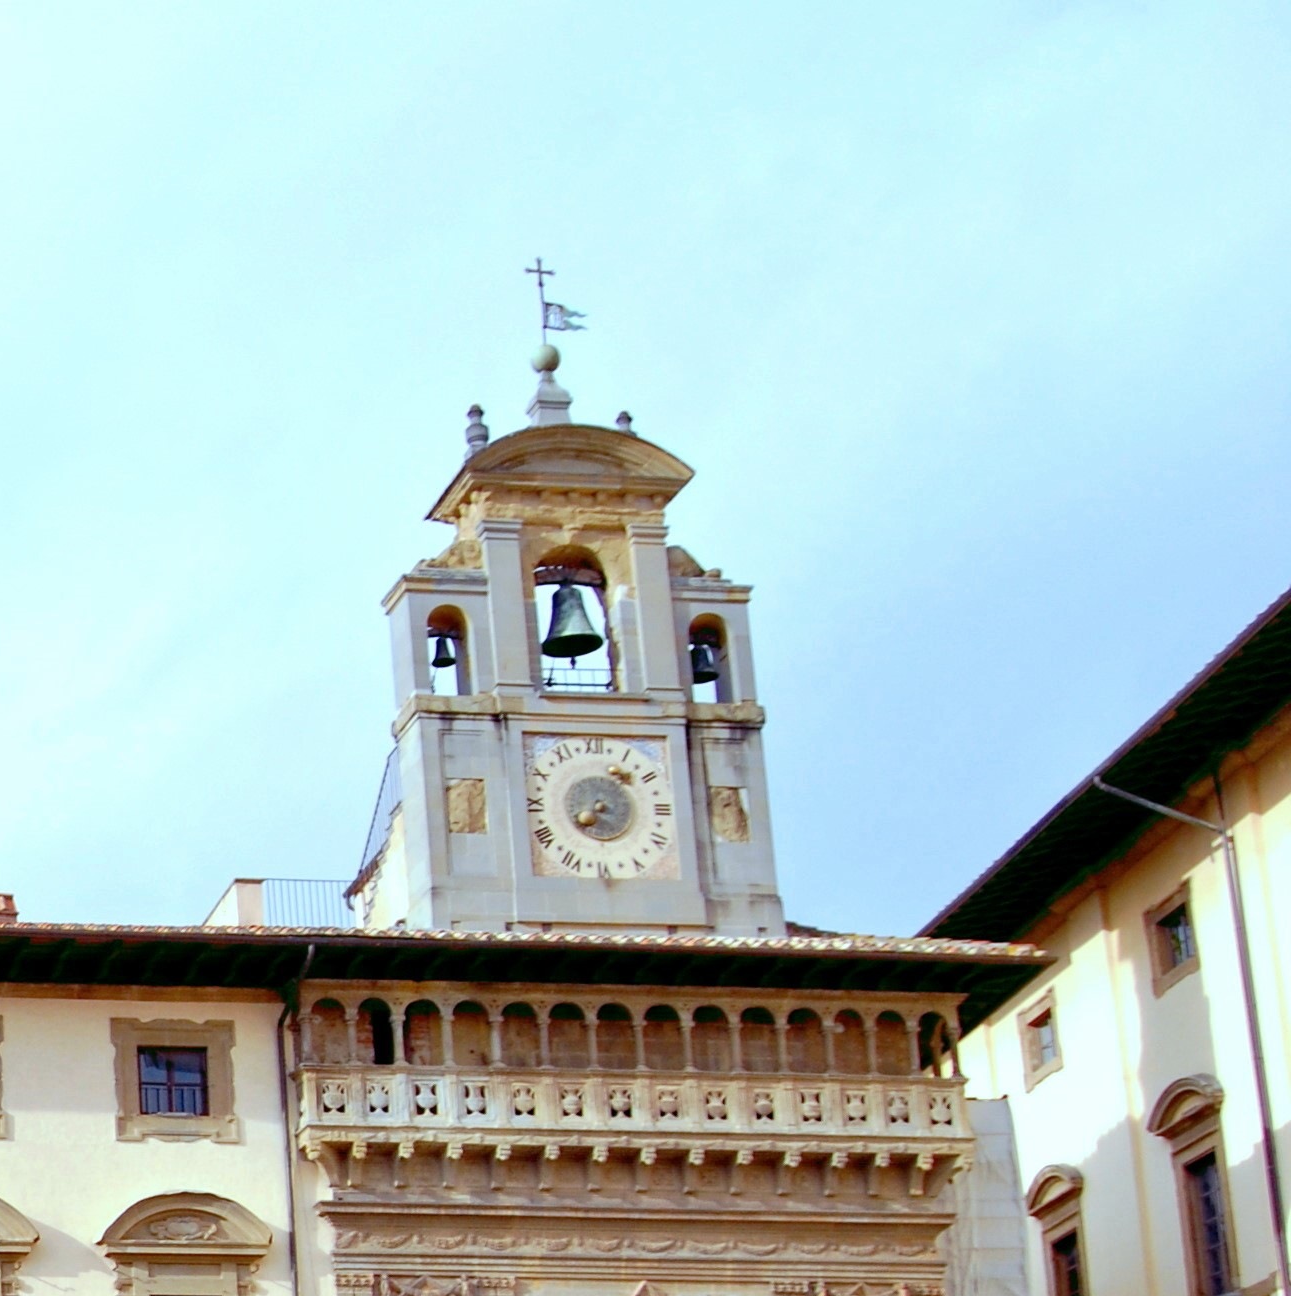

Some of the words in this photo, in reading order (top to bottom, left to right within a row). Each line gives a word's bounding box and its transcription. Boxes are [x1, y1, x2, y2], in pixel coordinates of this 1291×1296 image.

[552, 743, 573, 763] XI
[584, 738, 604, 754] XII
[532, 768, 550, 782] X
[641, 771, 657, 783] II
[526, 797, 544, 812] IX
[654, 803, 672, 816] III
[534, 826, 555, 849] VIII
[650, 832, 668, 850] IV
[561, 850, 582, 872] VII
[632, 857, 645, 872] V
